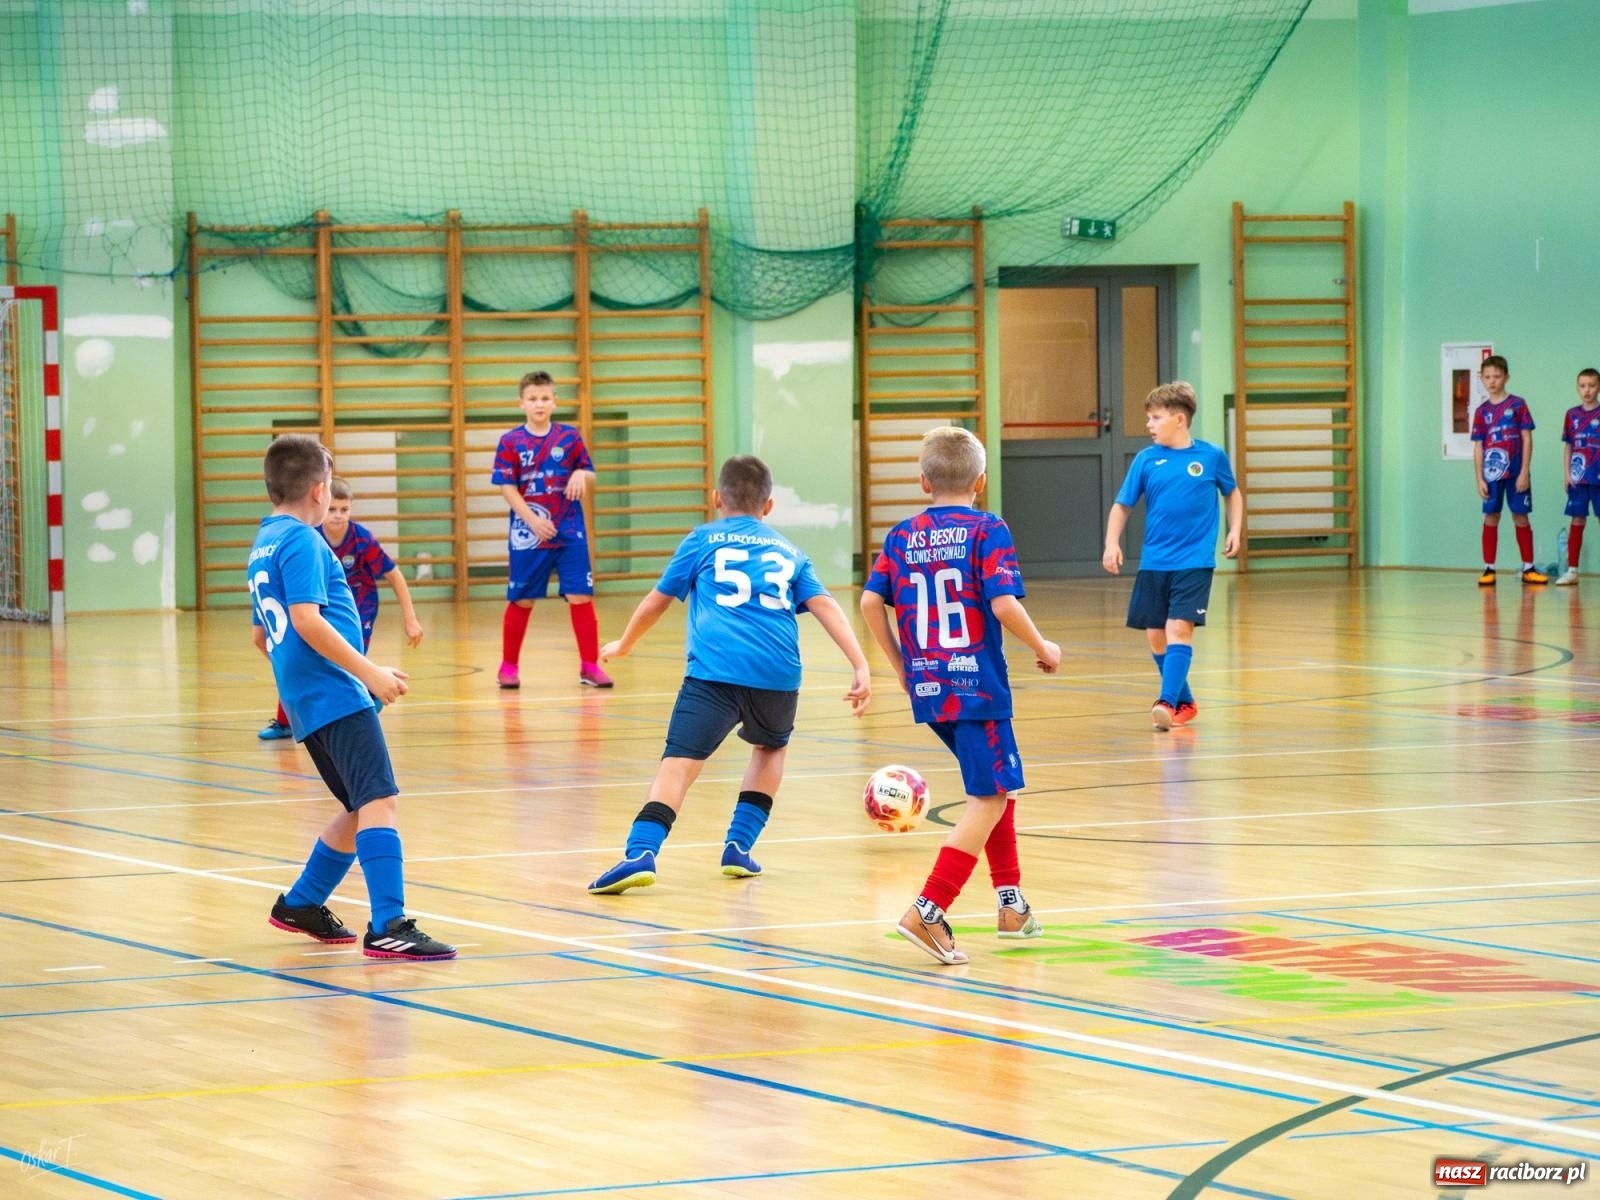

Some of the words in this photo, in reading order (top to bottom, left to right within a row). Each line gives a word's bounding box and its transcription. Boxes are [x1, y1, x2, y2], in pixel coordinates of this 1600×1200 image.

[519, 449, 535, 467] 52
[708, 532, 726, 544] LKS
[906, 530, 927, 549] LKS
[929, 526, 968, 547] BESKID
[714, 548, 796, 610] 53
[910, 567, 971, 650] 16
[951, 677, 980, 687] SOHO
[1000, 890, 1017, 905] FS
